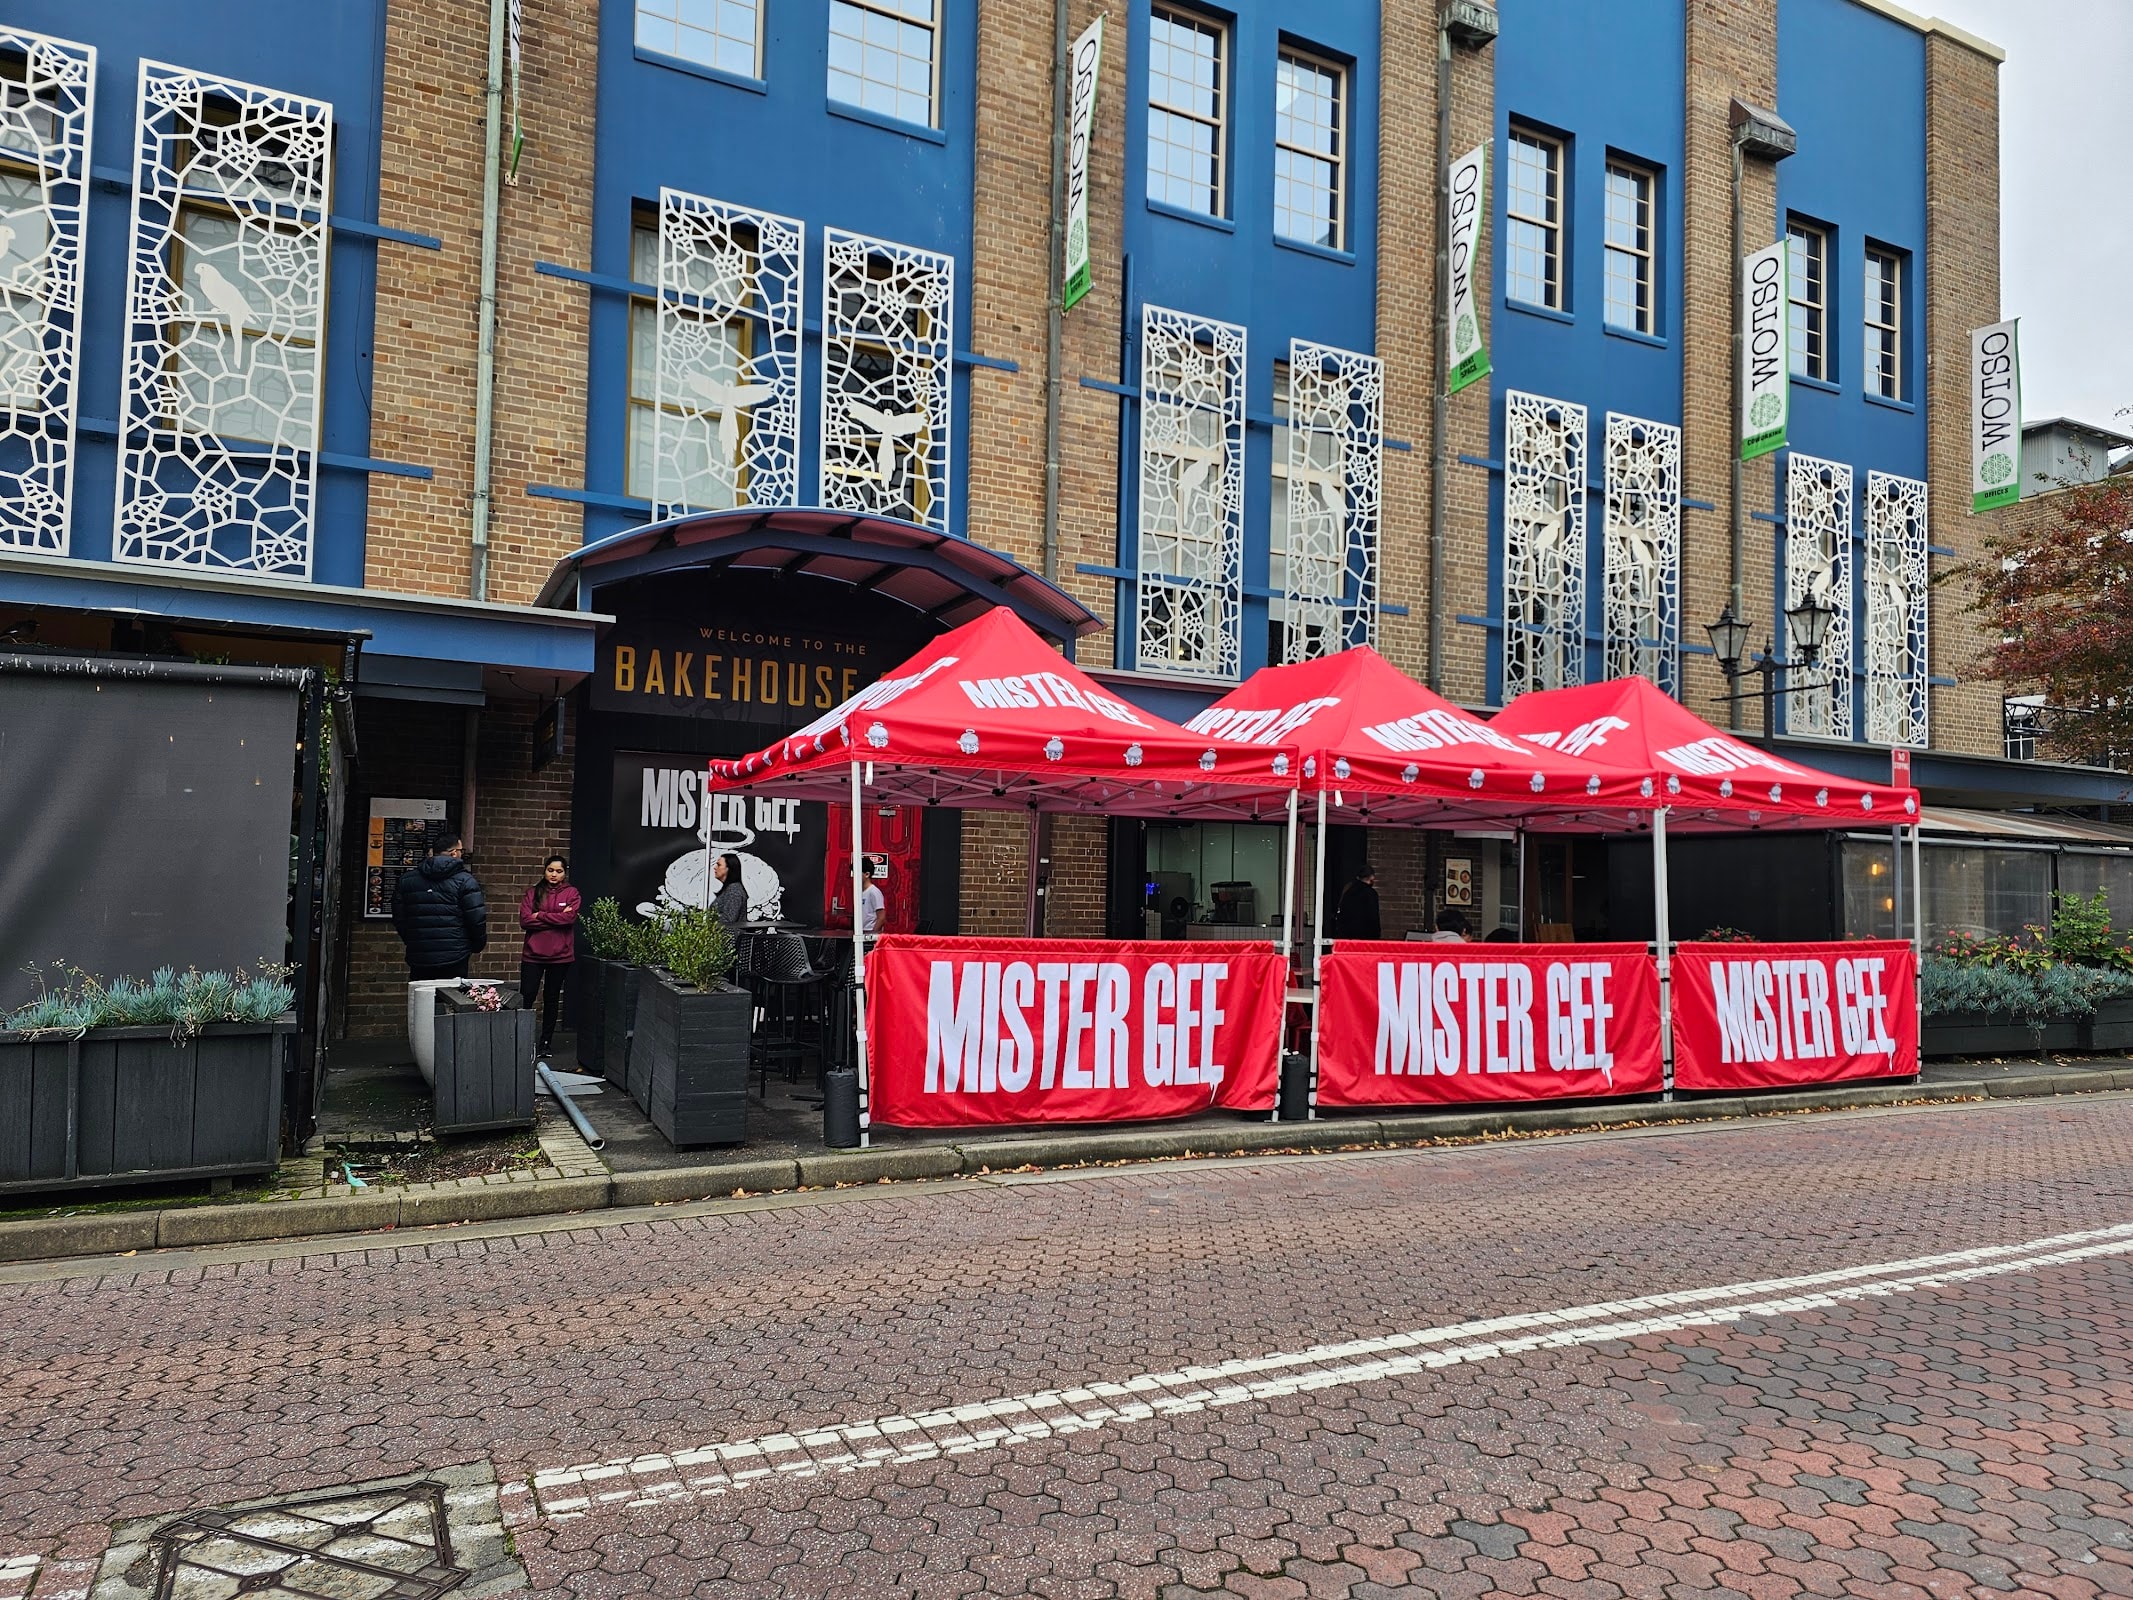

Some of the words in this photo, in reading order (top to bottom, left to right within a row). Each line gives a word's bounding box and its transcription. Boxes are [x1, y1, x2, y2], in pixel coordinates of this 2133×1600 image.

[1070, 38, 1097, 218] WOTSO
[1452, 164, 1478, 315] WOTSO
[1752, 257, 1779, 392] WOTSO
[1981, 332, 2012, 452] WOTSO
[1984, 487, 2009, 498] OFFICES
[614, 646, 858, 709] BAKEHOUSE
[700, 628, 792, 647] WELCOME
[803, 639, 824, 651] TO
[834, 642, 867, 656] THE
[959, 672, 1098, 714] MISTER
[1361, 709, 1490, 752] MISTER
[923, 960, 1131, 1094] MISTER
[1143, 961, 1229, 1104] GEE
[1374, 961, 1536, 1076] MISTER
[1546, 961, 1614, 1088] GEE
[1709, 959, 1836, 1064] MISTER
[1835, 957, 1896, 1072] GEE
